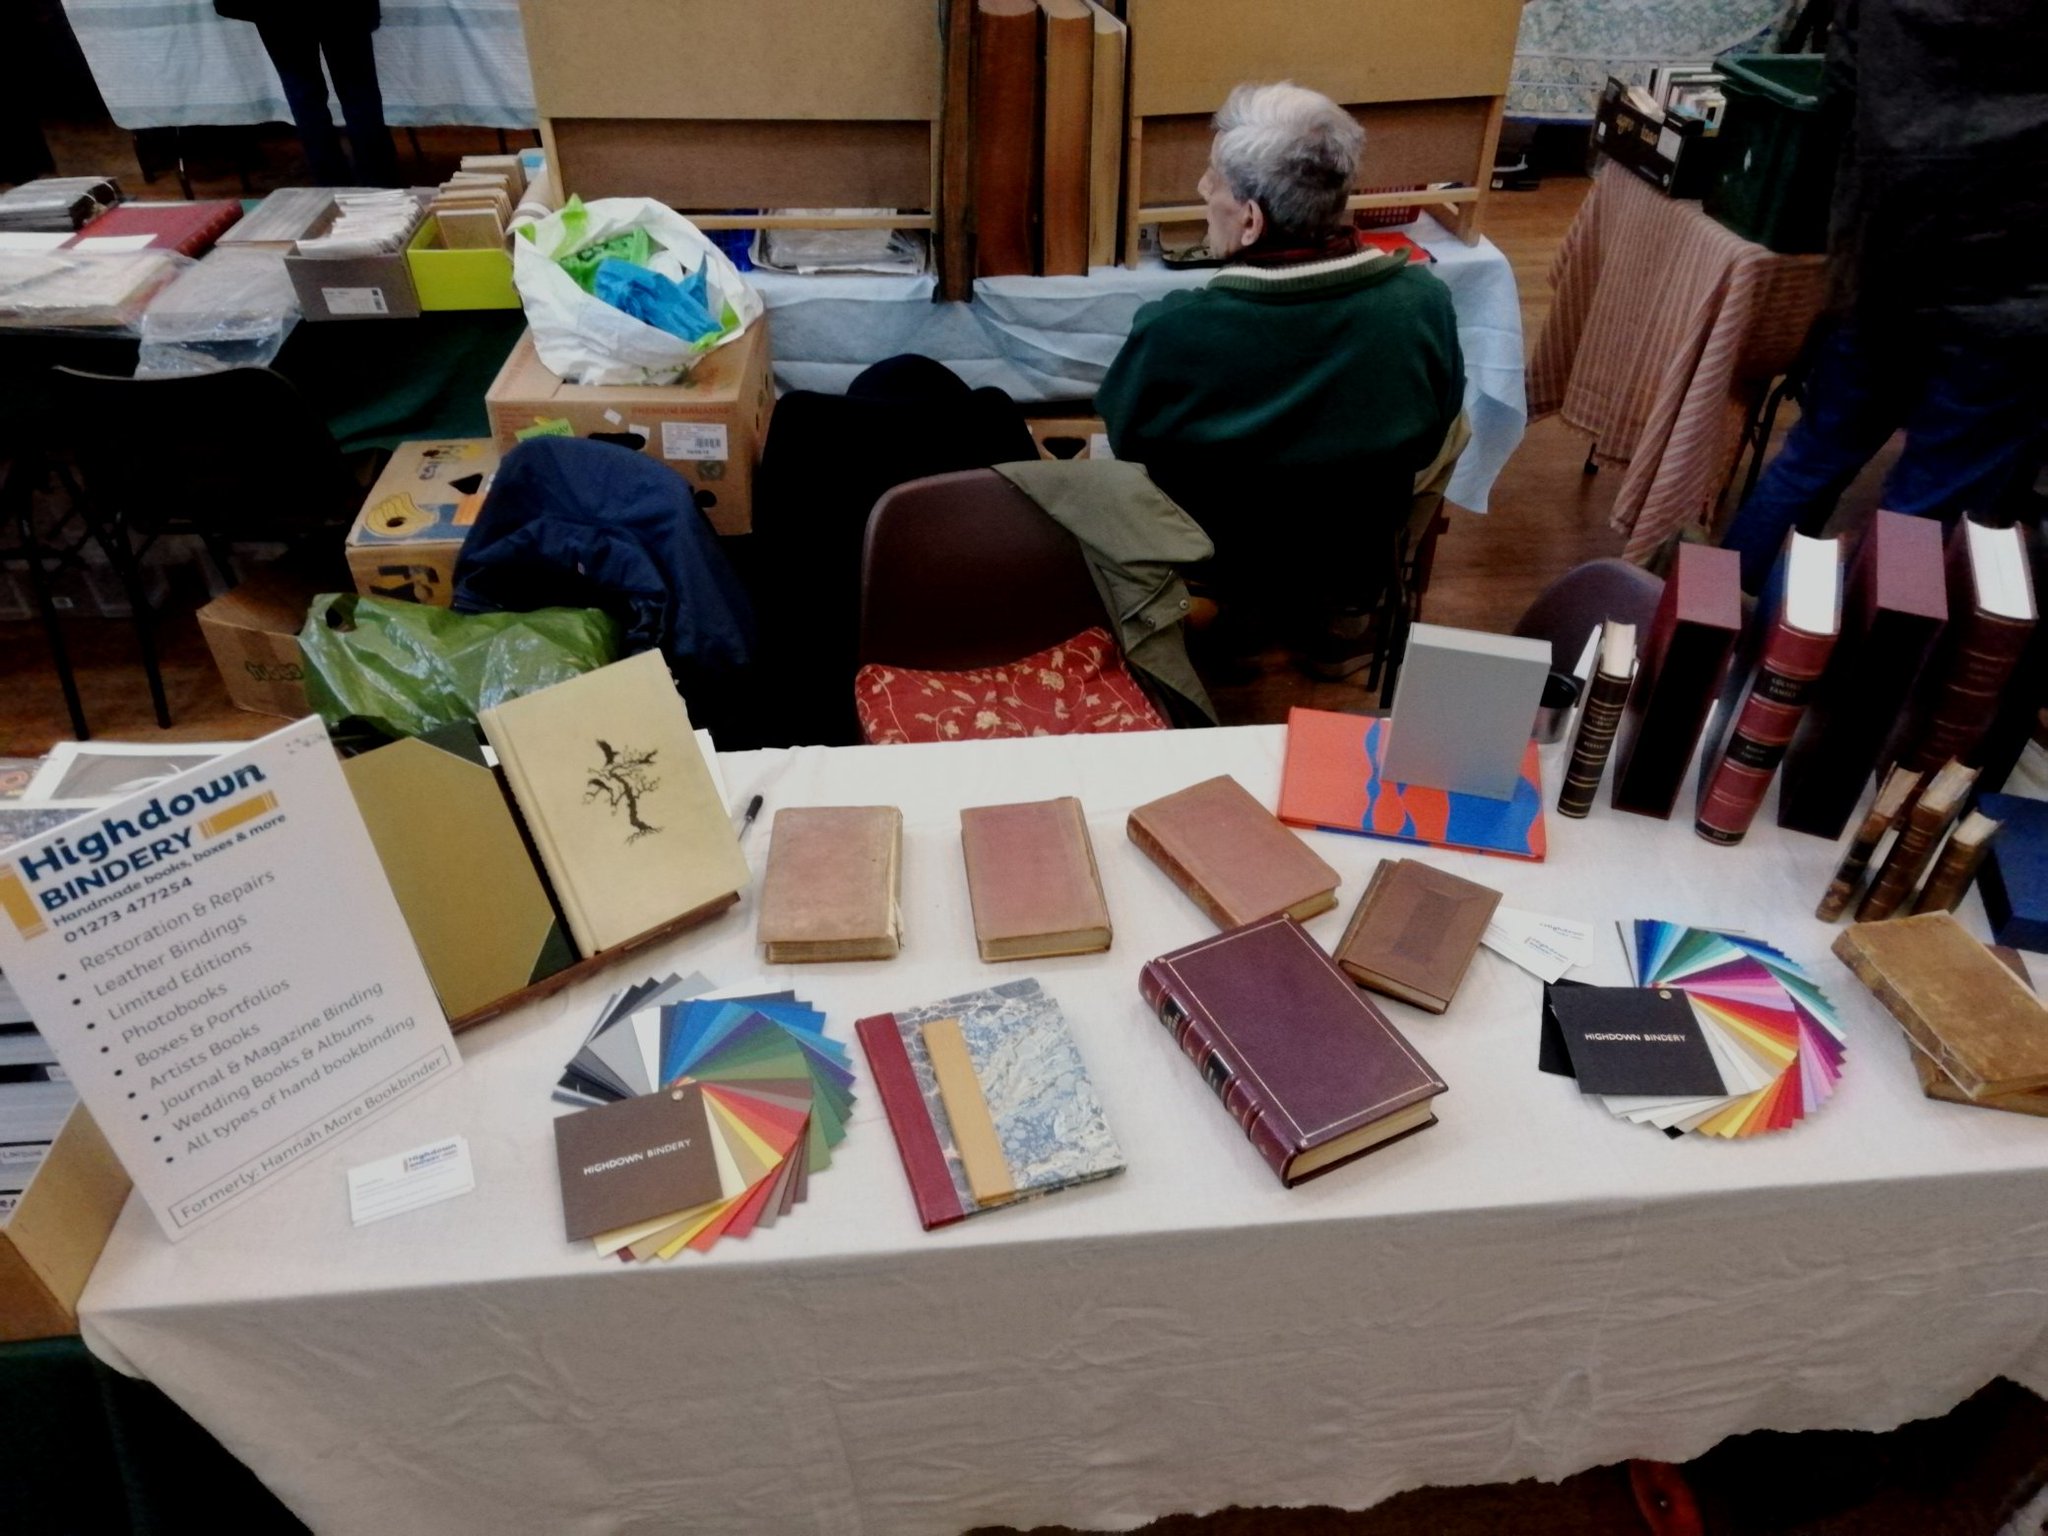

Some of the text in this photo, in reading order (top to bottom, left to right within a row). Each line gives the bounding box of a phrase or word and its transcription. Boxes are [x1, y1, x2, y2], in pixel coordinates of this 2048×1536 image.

[19, 763, 266, 883] Highdown
[38, 826, 193, 912] BINDERY
[53, 814, 286, 927] Handmade books, boxes & more
[64, 877, 193, 943] 01273 477254
[79, 870, 275, 971] Restoration & Repairs
[94, 913, 248, 996] Leather Bindings
[108, 941, 252, 1021] Limited Editions
[121, 983, 228, 1044] Photobooks
[135, 979, 290, 1067] Boxes & Portfolios
[150, 1023, 261, 1089] Artists Books
[160, 982, 384, 1115] Journal & Magazine Binding
[172, 1014, 375, 1132] Wedding Books & Albums
[1584, 1033, 1686, 1042] HIGHDOWN BINDERY
[186, 1016, 416, 1154] All types of hand bookbinding
[180, 1056, 443, 1220] Formerly: Hannah More Bookbinder
[583, 1138, 691, 1176] HIGHDOWN BINDERY
